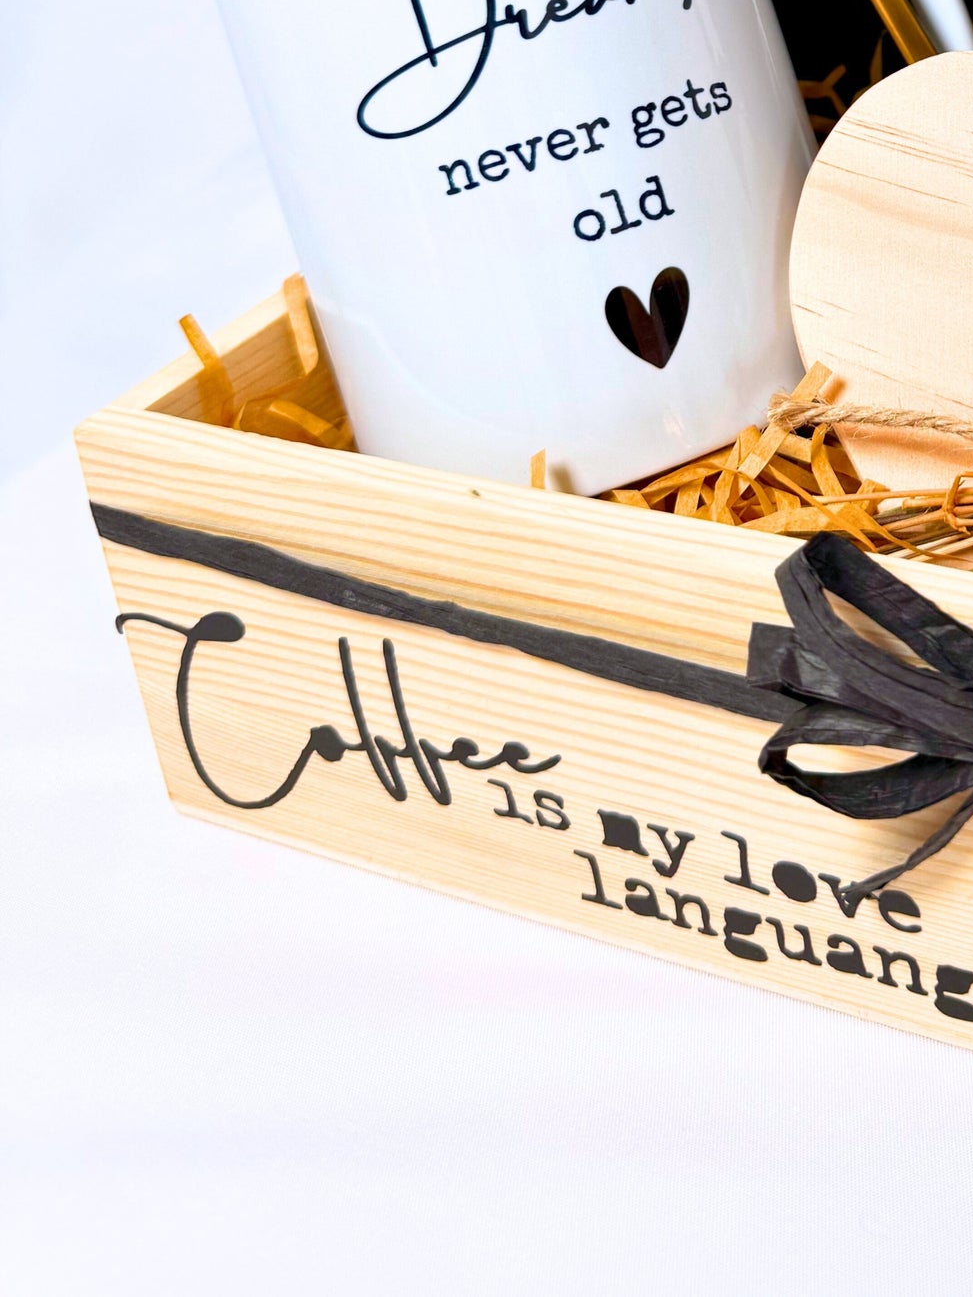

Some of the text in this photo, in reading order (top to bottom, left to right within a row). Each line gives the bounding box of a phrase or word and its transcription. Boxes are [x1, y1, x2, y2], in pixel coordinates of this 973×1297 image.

[438, 79, 733, 196] never gets
[572, 175, 675, 242] old
[115, 610, 562, 809] Coffee
[486, 778, 923, 933] is my love
